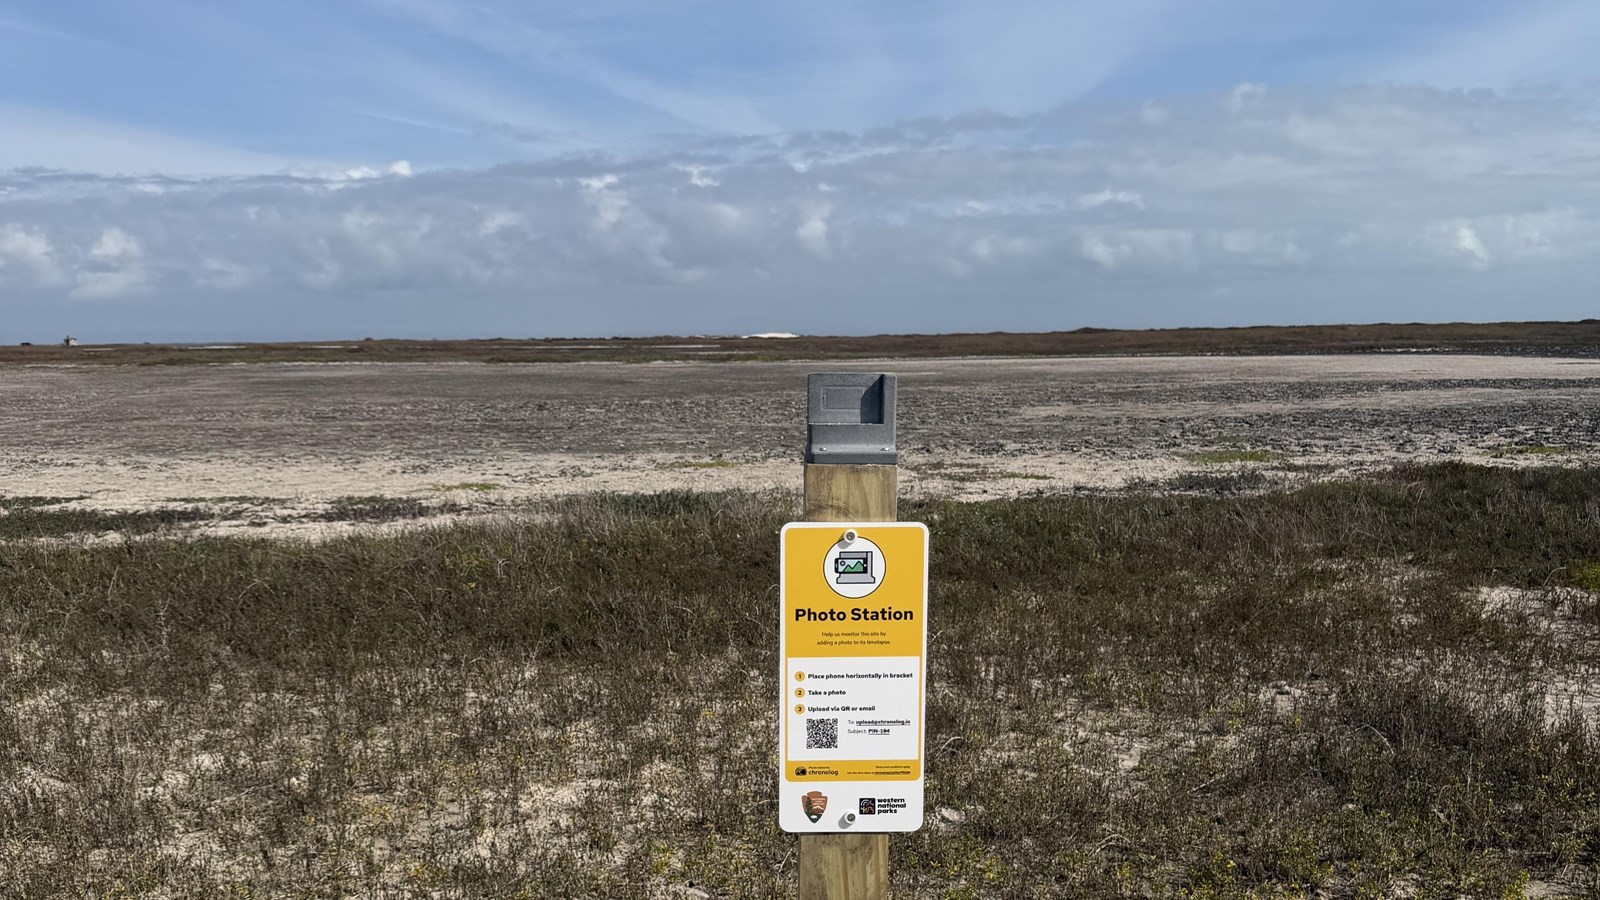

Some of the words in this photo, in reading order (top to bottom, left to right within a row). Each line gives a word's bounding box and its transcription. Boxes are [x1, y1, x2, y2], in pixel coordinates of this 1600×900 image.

[795, 608, 846, 621] Photo
[851, 607, 913, 620] Station
[846, 672, 882, 680] horizontally
